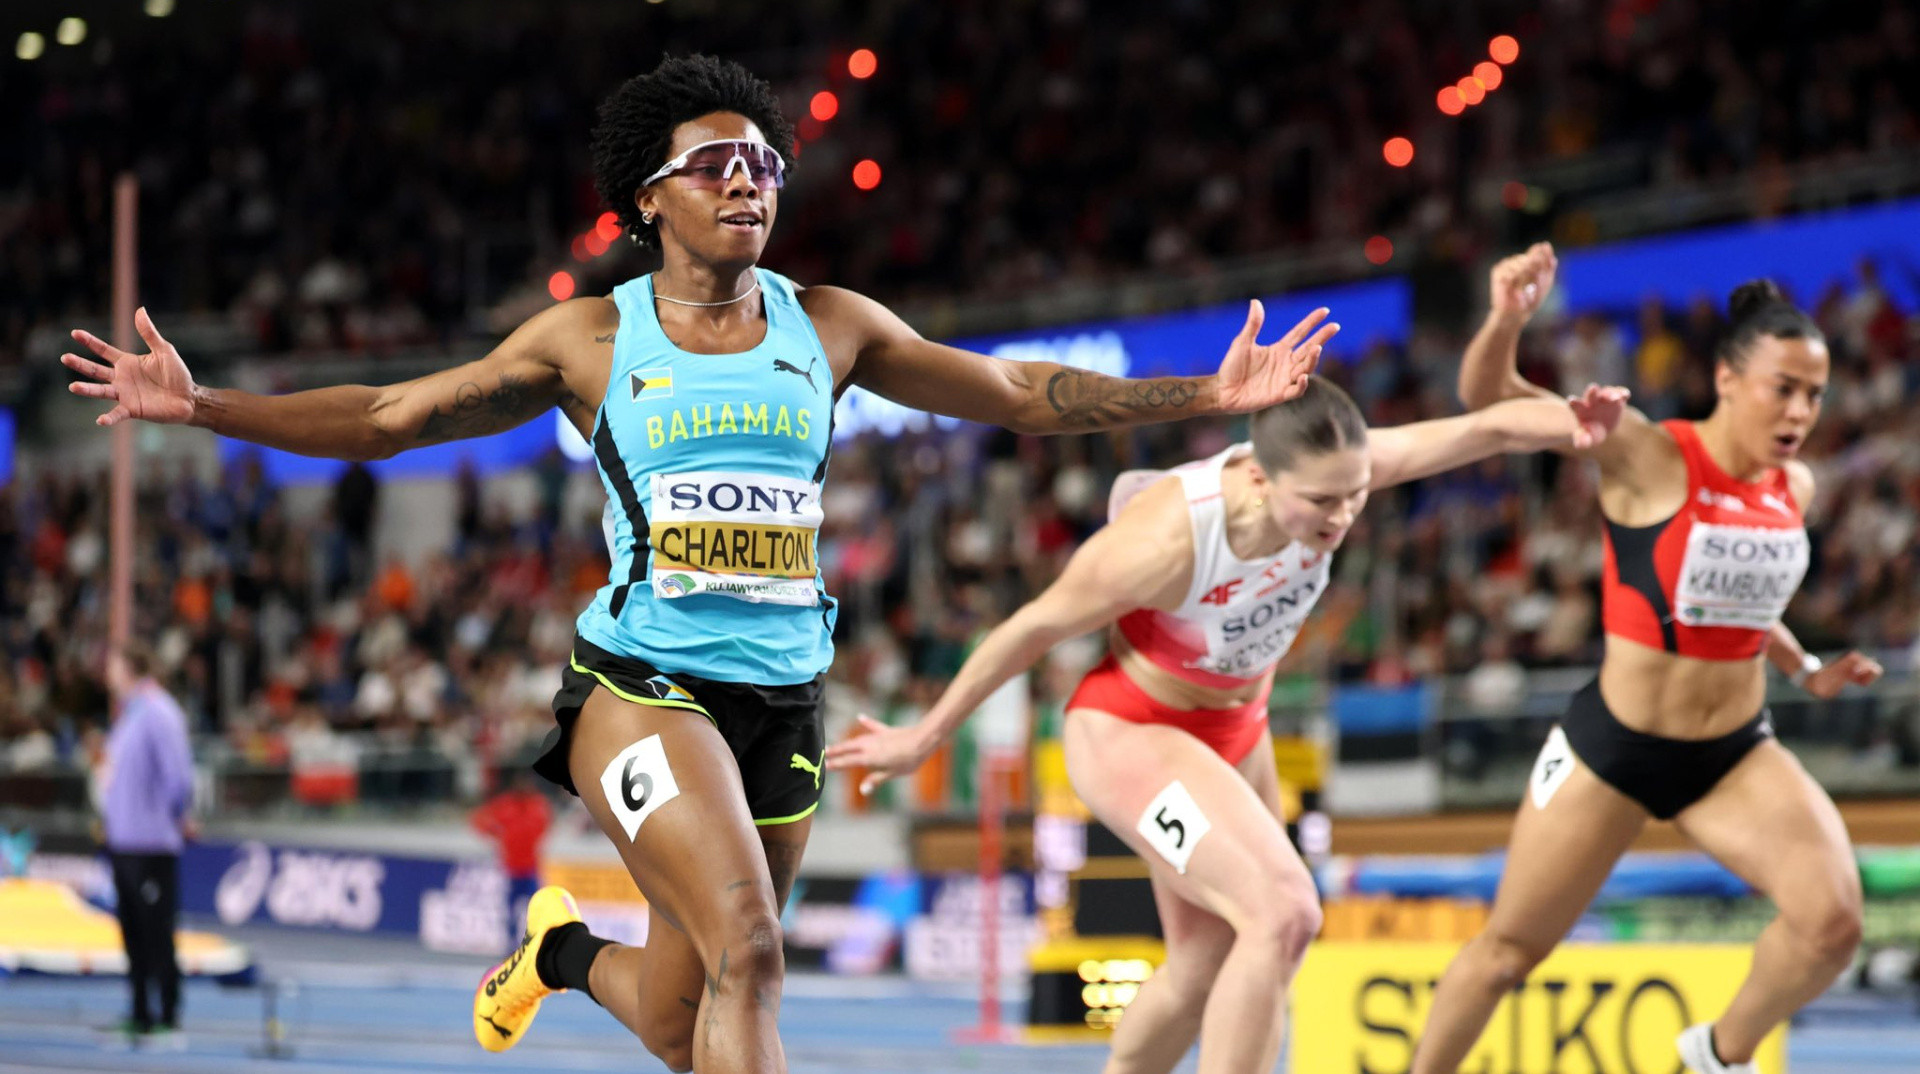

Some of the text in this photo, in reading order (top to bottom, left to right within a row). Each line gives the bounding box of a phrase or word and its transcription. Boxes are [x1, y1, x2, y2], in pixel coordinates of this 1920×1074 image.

[646, 402, 811, 449] BAHAMAS
[670, 482, 808, 514] SONY
[660, 526, 811, 571] CHARLTON
[1703, 534, 1801, 563] SONY
[621, 755, 653, 812] 6
[1154, 806, 1186, 849] 5
[1355, 976, 1695, 1074] SIKO
